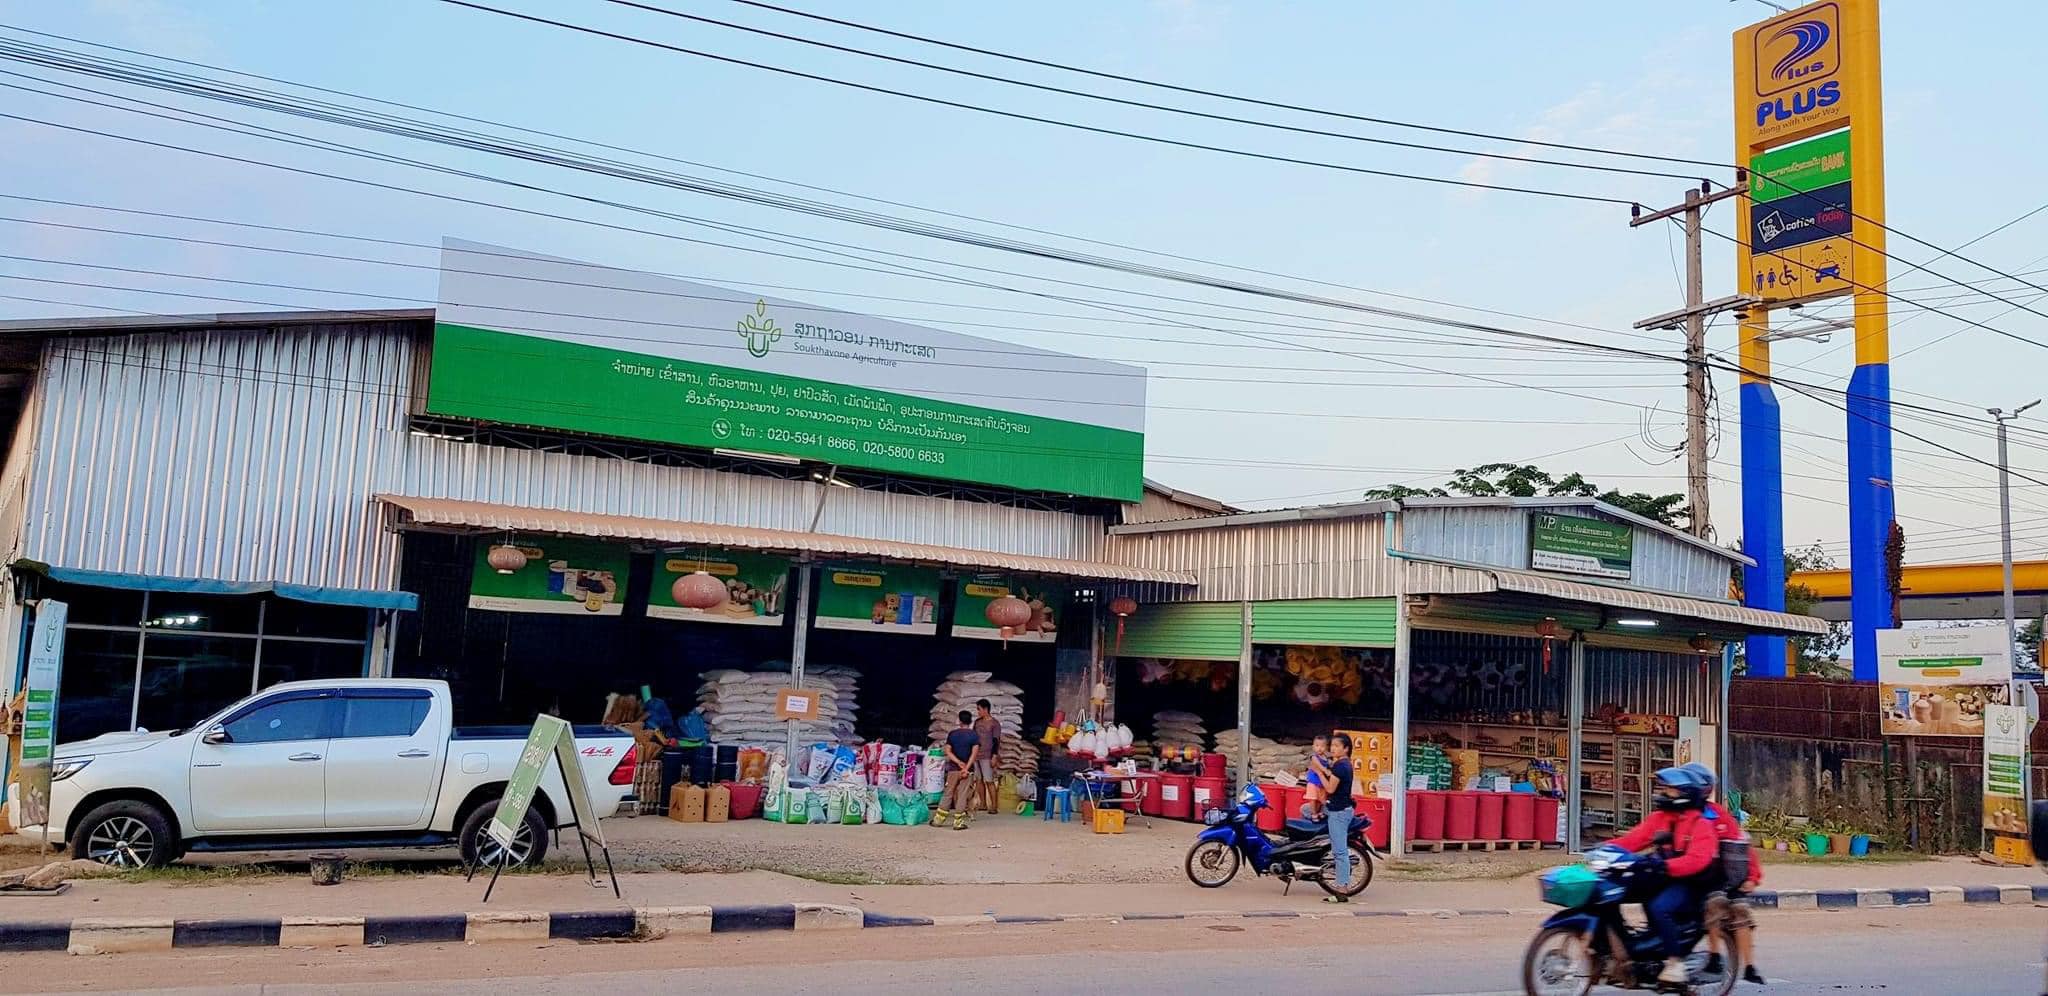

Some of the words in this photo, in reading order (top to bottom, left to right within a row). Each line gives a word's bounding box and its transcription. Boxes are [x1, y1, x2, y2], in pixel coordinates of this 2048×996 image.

[1757, 80, 1841, 127] PLUS
[1758, 124, 1782, 136] Along
[1782, 117, 1800, 130] with
[1802, 112, 1820, 123] Your
[1822, 106, 1840, 117] Way
[1821, 151, 1845, 173] BANK
[794, 342, 850, 359] Soukthavone
[852, 352, 897, 368] Agriculture
[869, 336, 936, 359] ການກະເສດ
[767, 427, 822, 447] 020-5941
[827, 437, 859, 454] 8666,
[863, 441, 915, 460] 020-5800
[918, 450, 945, 464] 6633
[1539, 515, 1556, 529] MP
